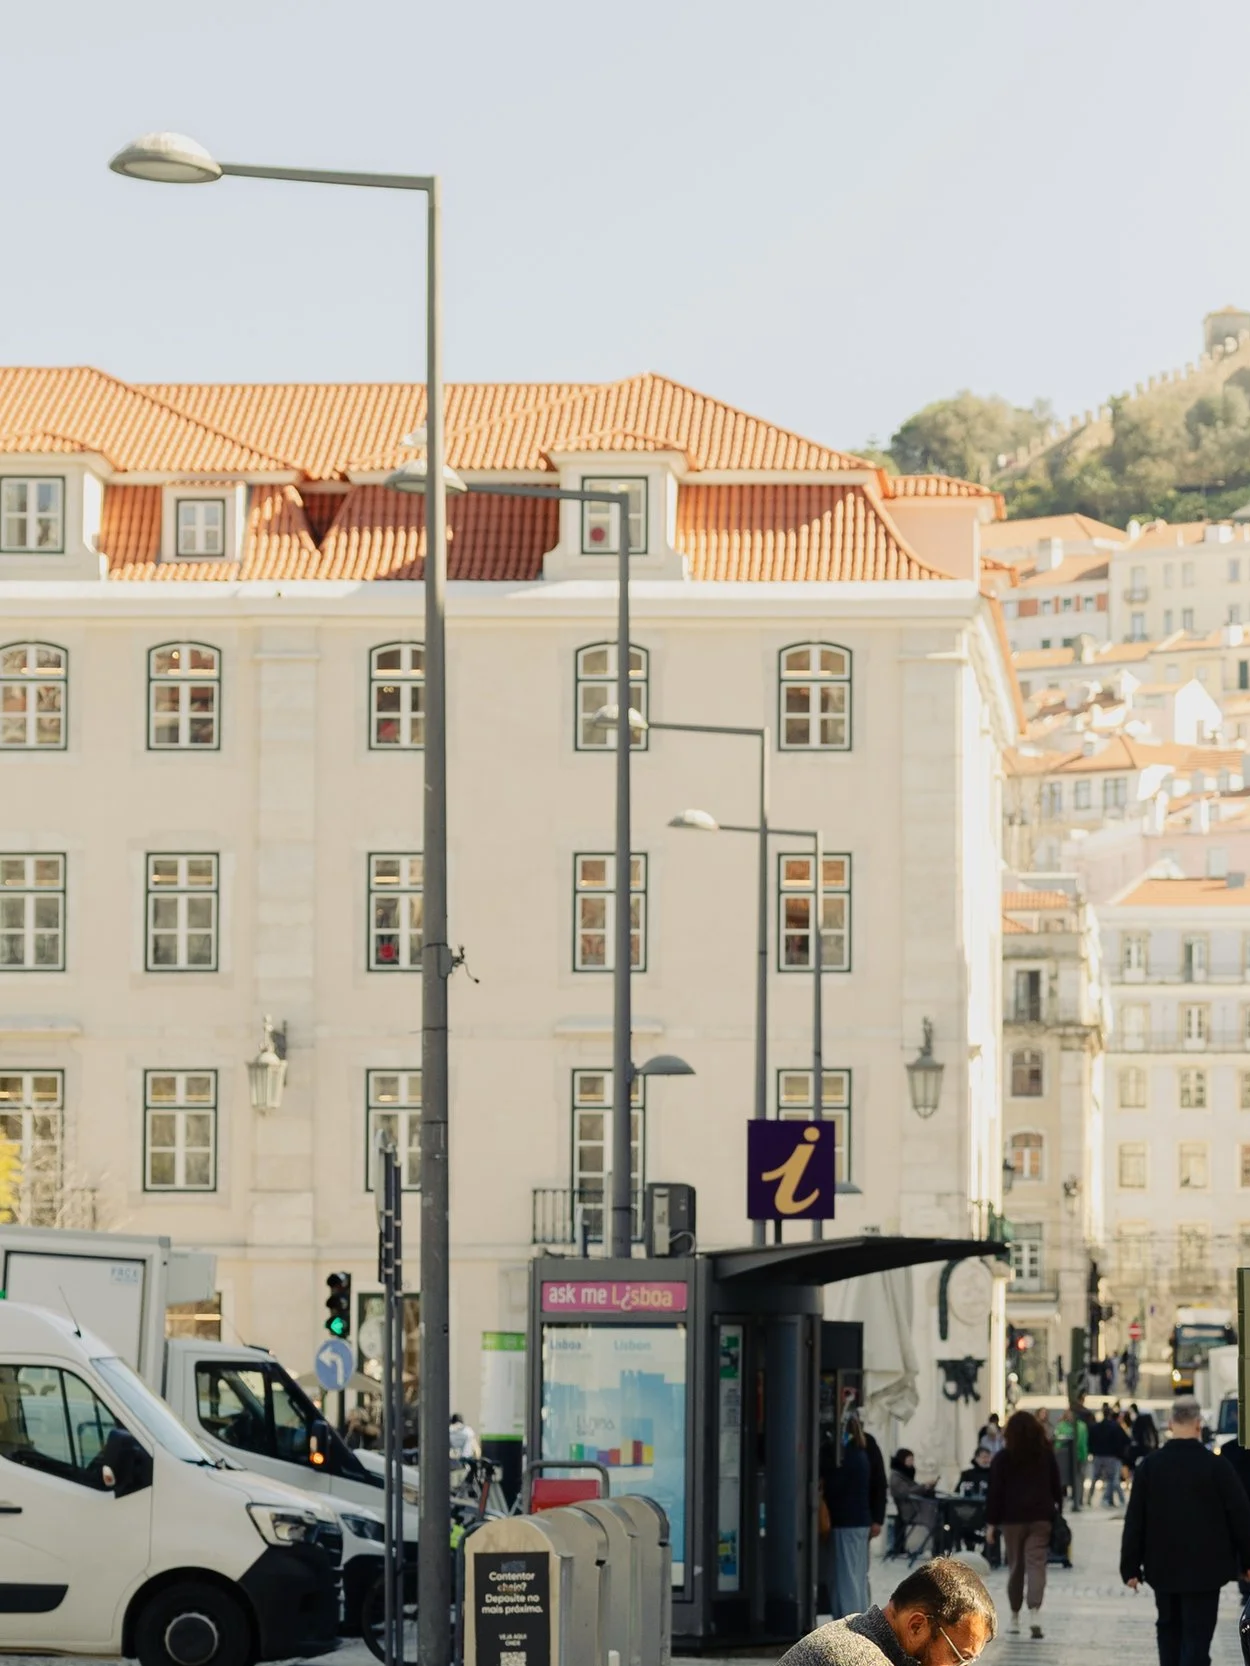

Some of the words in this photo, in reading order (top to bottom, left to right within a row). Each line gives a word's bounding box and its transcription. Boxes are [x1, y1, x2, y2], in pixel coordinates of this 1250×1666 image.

[761, 1126, 820, 1214] i
[549, 1283, 576, 1304] ask
[581, 1287, 608, 1305] me
[488, 1571, 535, 1581] Contentor
[485, 1594, 526, 1604] Deposite
[527, 1595, 540, 1603] no
[481, 1605, 504, 1615] mais
